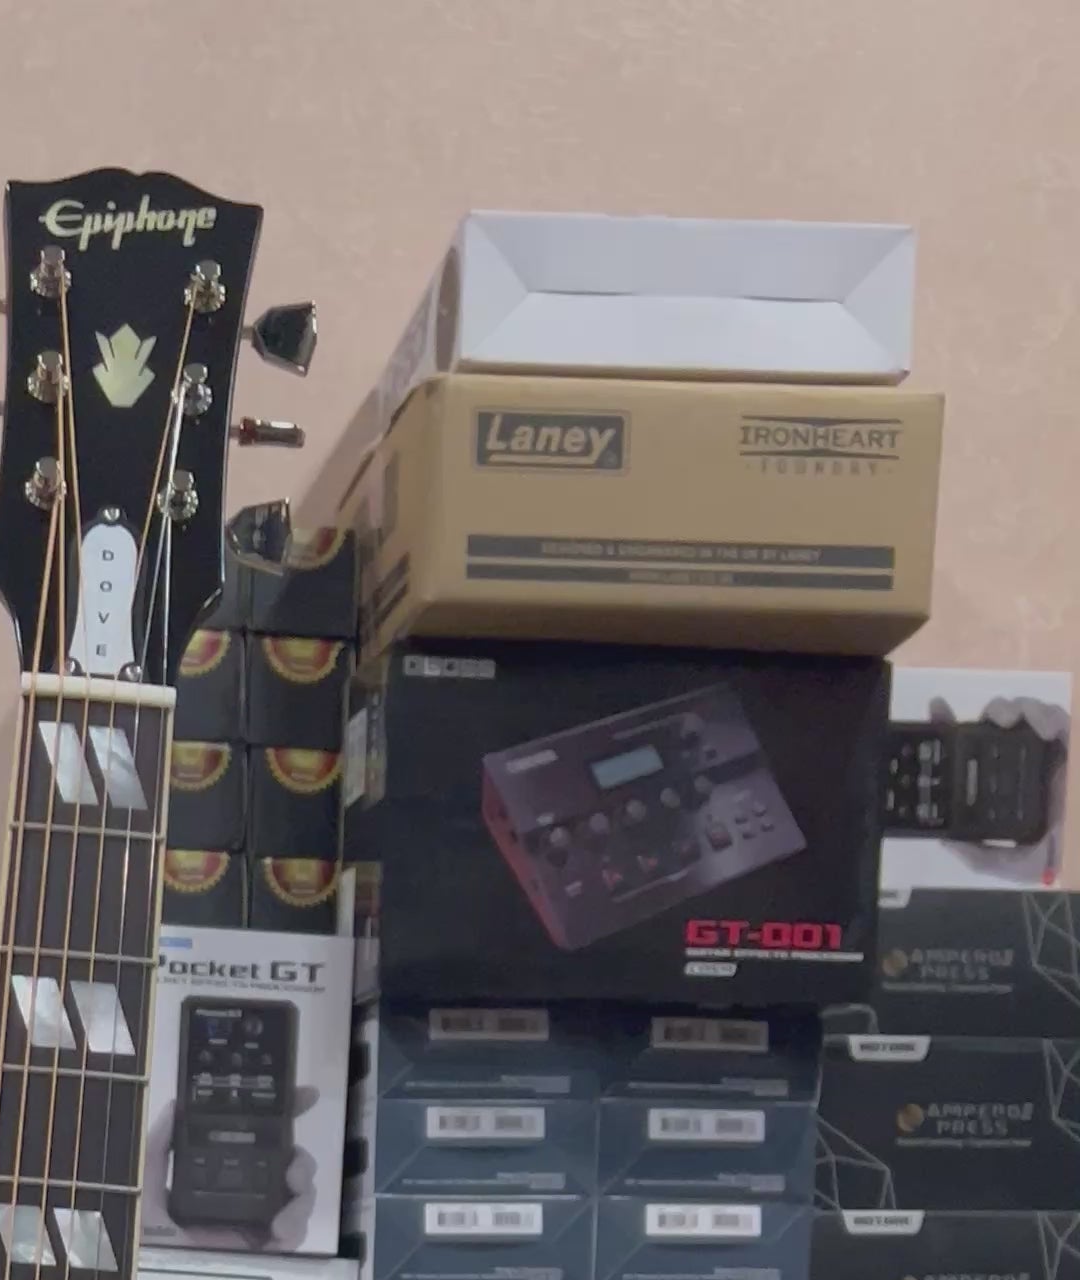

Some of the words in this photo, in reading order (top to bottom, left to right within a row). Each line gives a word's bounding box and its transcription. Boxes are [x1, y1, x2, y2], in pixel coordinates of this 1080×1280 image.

[38, 194, 217, 251] Epiphone
[485, 413, 617, 465] Laney
[739, 425, 901, 449] IRONHEART
[96, 548, 115, 657] DOVE
[685, 919, 842, 950] GT-001
[270, 960, 325, 983] GT
